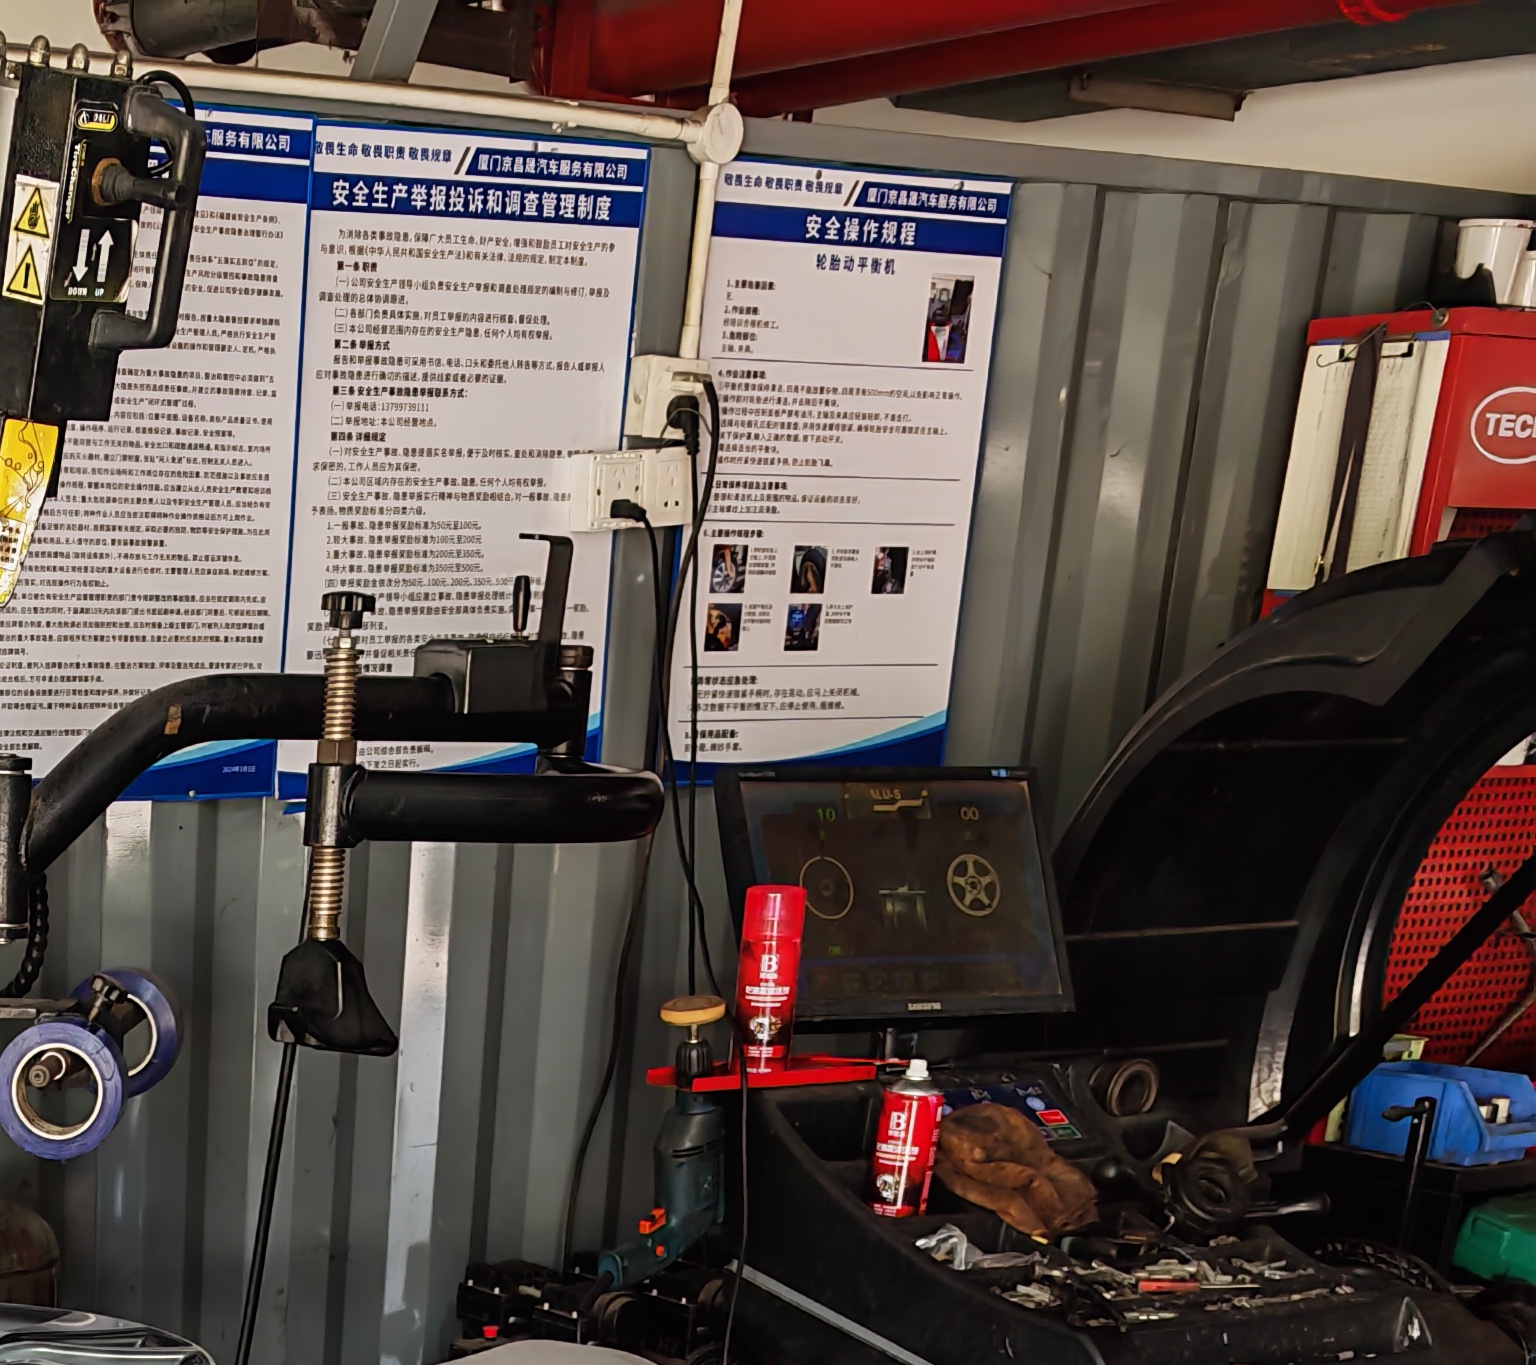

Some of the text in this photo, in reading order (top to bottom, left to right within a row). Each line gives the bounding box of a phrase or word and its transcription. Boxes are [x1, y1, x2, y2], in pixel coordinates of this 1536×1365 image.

[361, 143, 406, 161] 敬畏职责
[408, 146, 452, 163] 敬畏规章
[478, 154, 628, 180] 厦门京昌晟汽车服务有限公司
[724, 173, 843, 195] 敬畏生命 敬畏职责 敬畏规章
[332, 179, 613, 222] 安全生产举报投诉和调查管理制度
[805, 214, 917, 246] 安全操作规程
[815, 252, 896, 276] 轮胎动平衡机
[67, 287, 105, 297] DOWN UP
